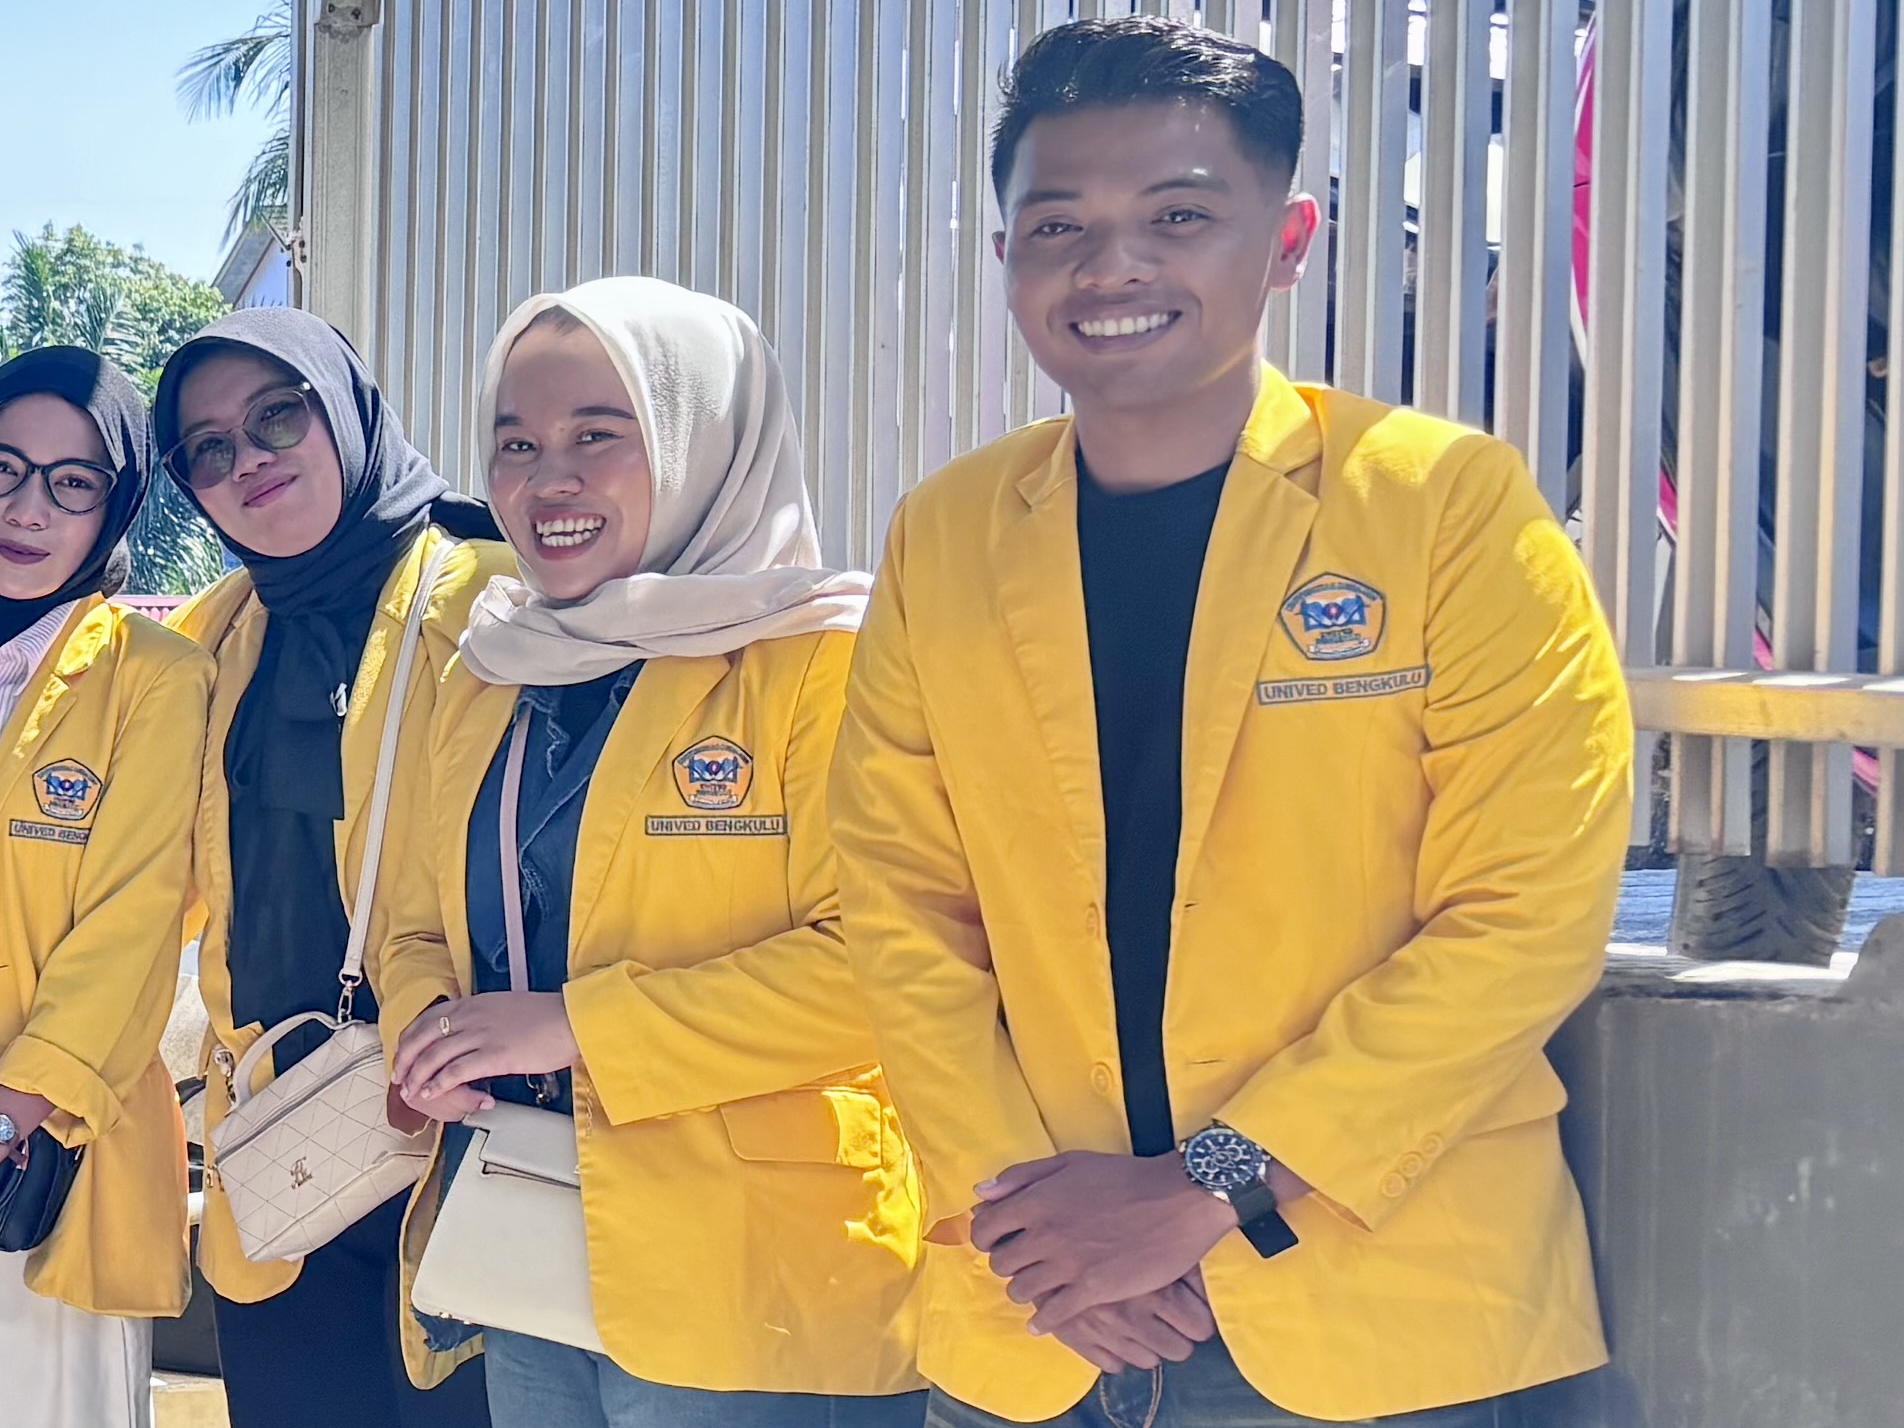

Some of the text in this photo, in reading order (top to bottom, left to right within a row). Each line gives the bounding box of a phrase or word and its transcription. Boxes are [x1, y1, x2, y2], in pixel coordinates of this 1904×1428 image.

[1263, 672, 1422, 699] UNIVED BENGKULU
[651, 818, 780, 833] UNIVED BENGKULU
